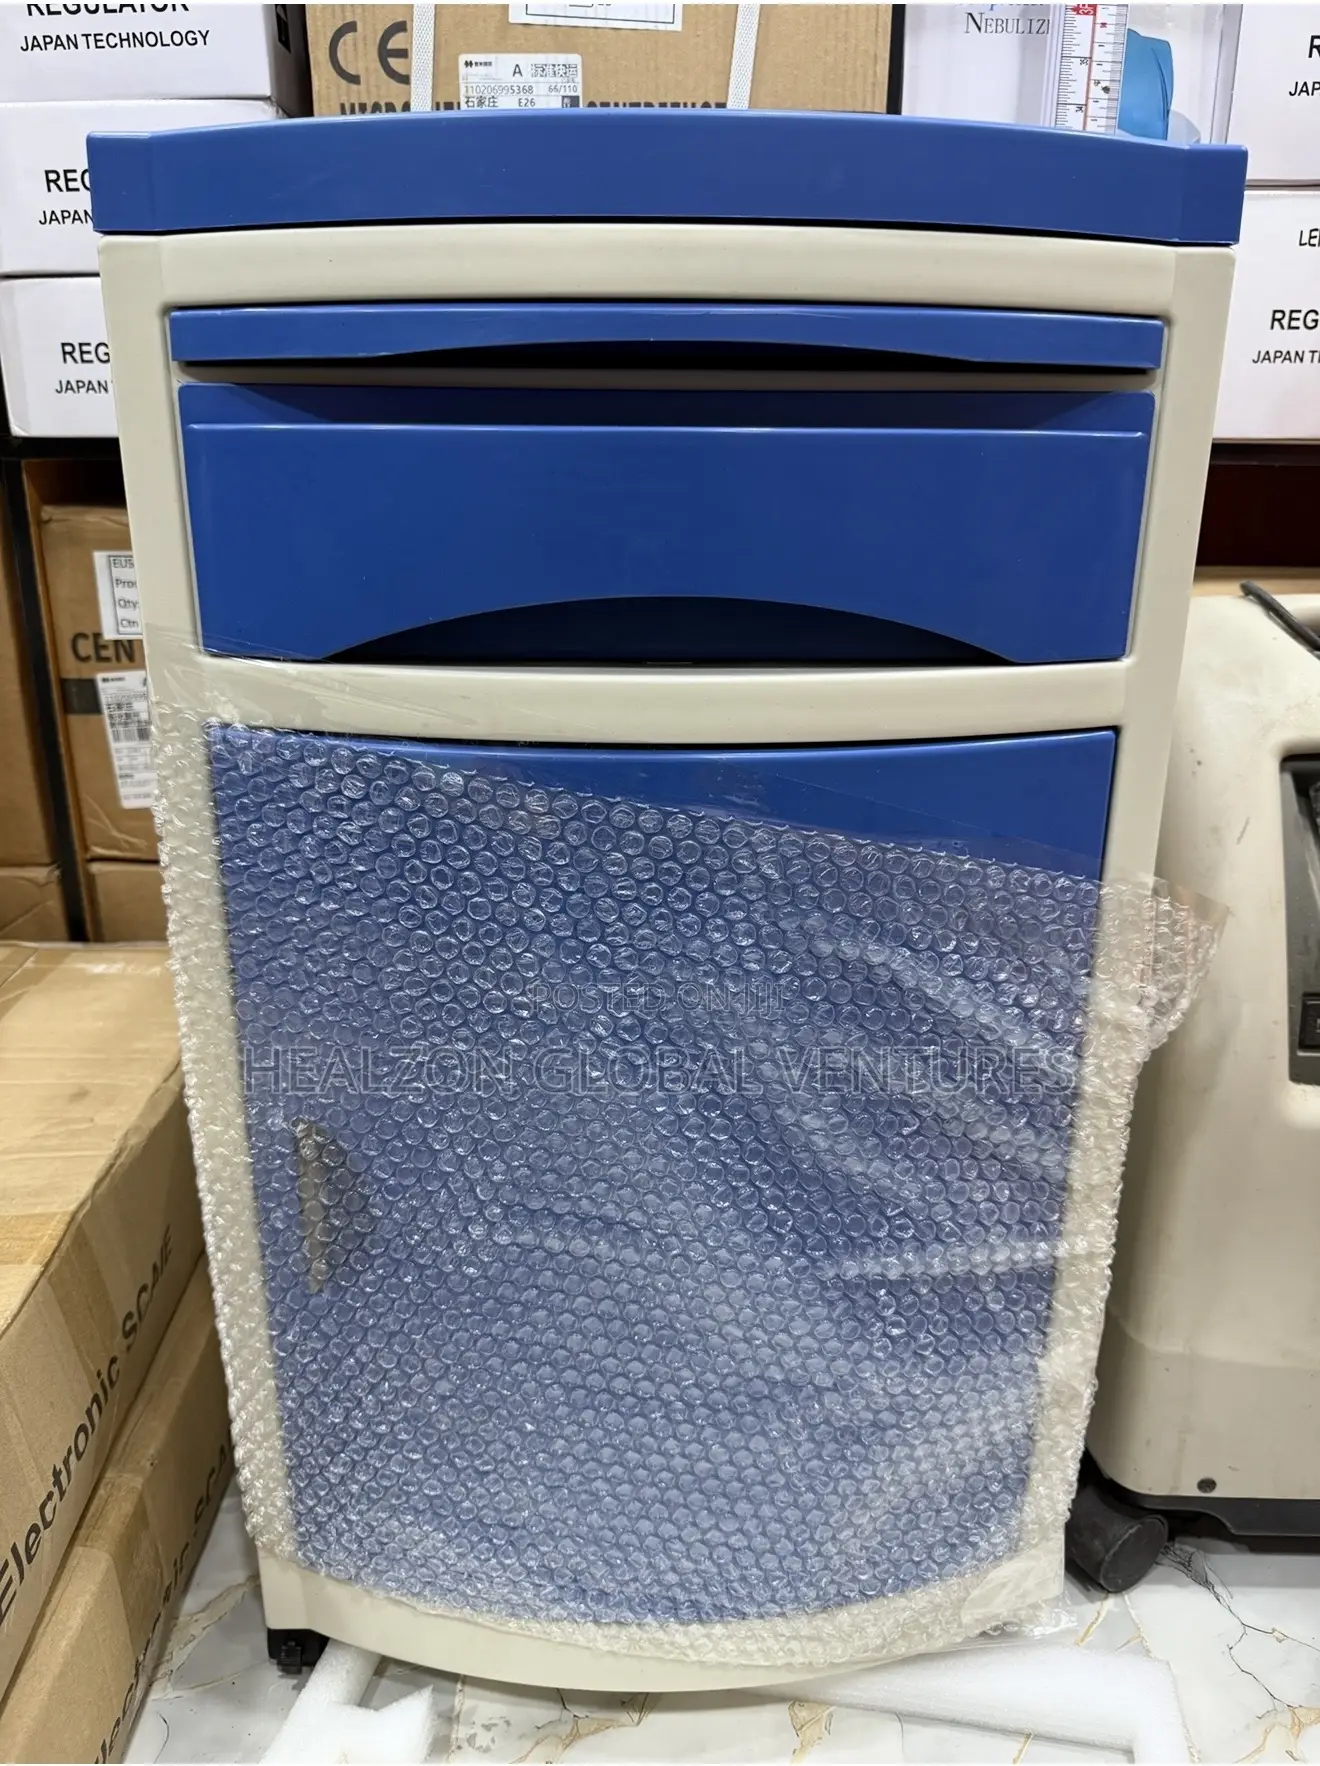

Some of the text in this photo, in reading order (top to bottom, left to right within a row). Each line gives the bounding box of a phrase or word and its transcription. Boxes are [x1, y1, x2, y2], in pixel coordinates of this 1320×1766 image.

[20, 30, 210, 52] JAPAN TECHNOLOGY
[328, 20, 411, 85] CE
[512, 64, 523, 77] A
[464, 85, 578, 94] 110206995368 66/110
[464, 96, 499, 108] 石家庄
[518, 98, 536, 107] E26
[1299, 228, 1320, 247] LE
[1270, 309, 1319, 331] REG
[61, 342, 110, 364] REG
[1252, 350, 1305, 364] JAPAN
[55, 379, 109, 394] JAPAN
[72, 632, 135, 663] CEN
